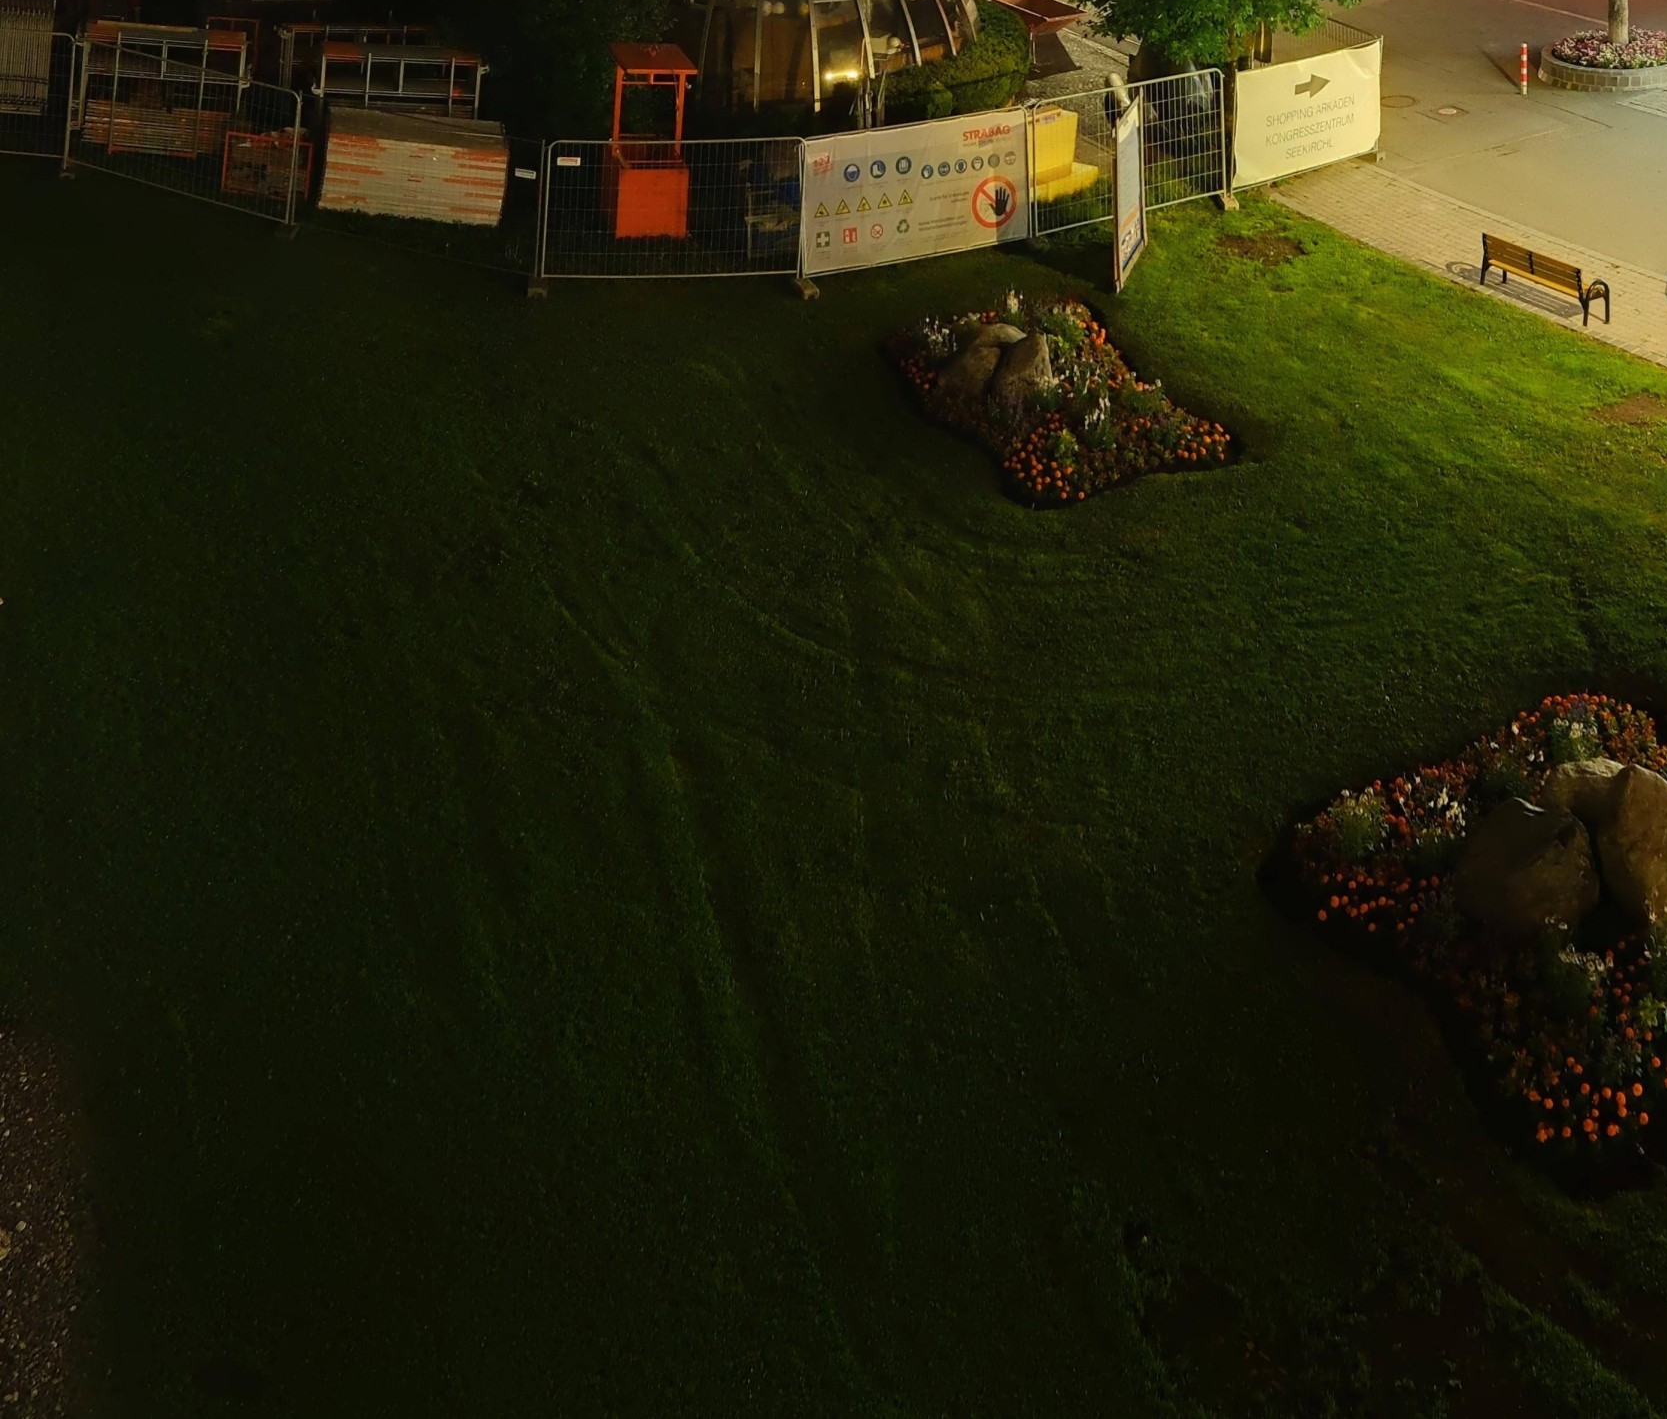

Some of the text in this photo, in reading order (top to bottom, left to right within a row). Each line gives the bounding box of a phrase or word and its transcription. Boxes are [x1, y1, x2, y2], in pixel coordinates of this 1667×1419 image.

[1266, 95, 1355, 128] SHOPPING ARKADEN
[962, 124, 1011, 142] STRABAG
[1265, 113, 1354, 146] KONGRESSZENTRUM
[1285, 138, 1334, 159] SEEKIRCHL
